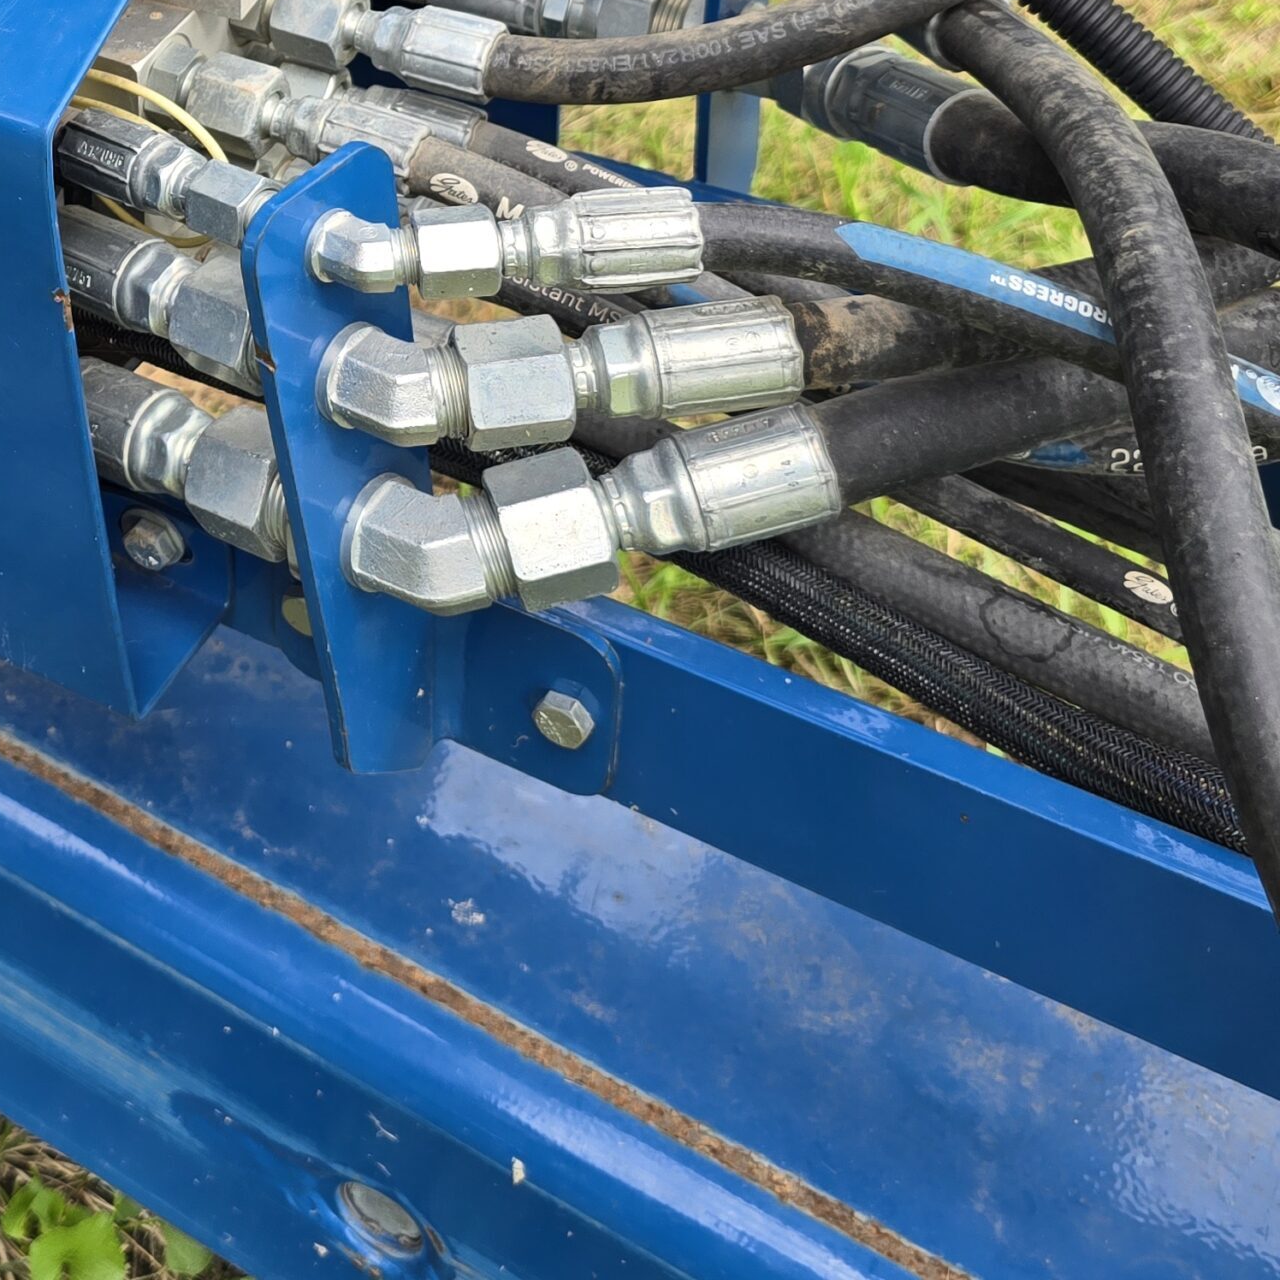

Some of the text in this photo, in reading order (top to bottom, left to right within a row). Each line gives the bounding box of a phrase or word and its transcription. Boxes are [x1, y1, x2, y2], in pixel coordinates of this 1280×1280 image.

[739, 22, 787, 49] SAE
[429, 174, 478, 205] Gates
[990, 271, 1115, 324] ROGRESS™
